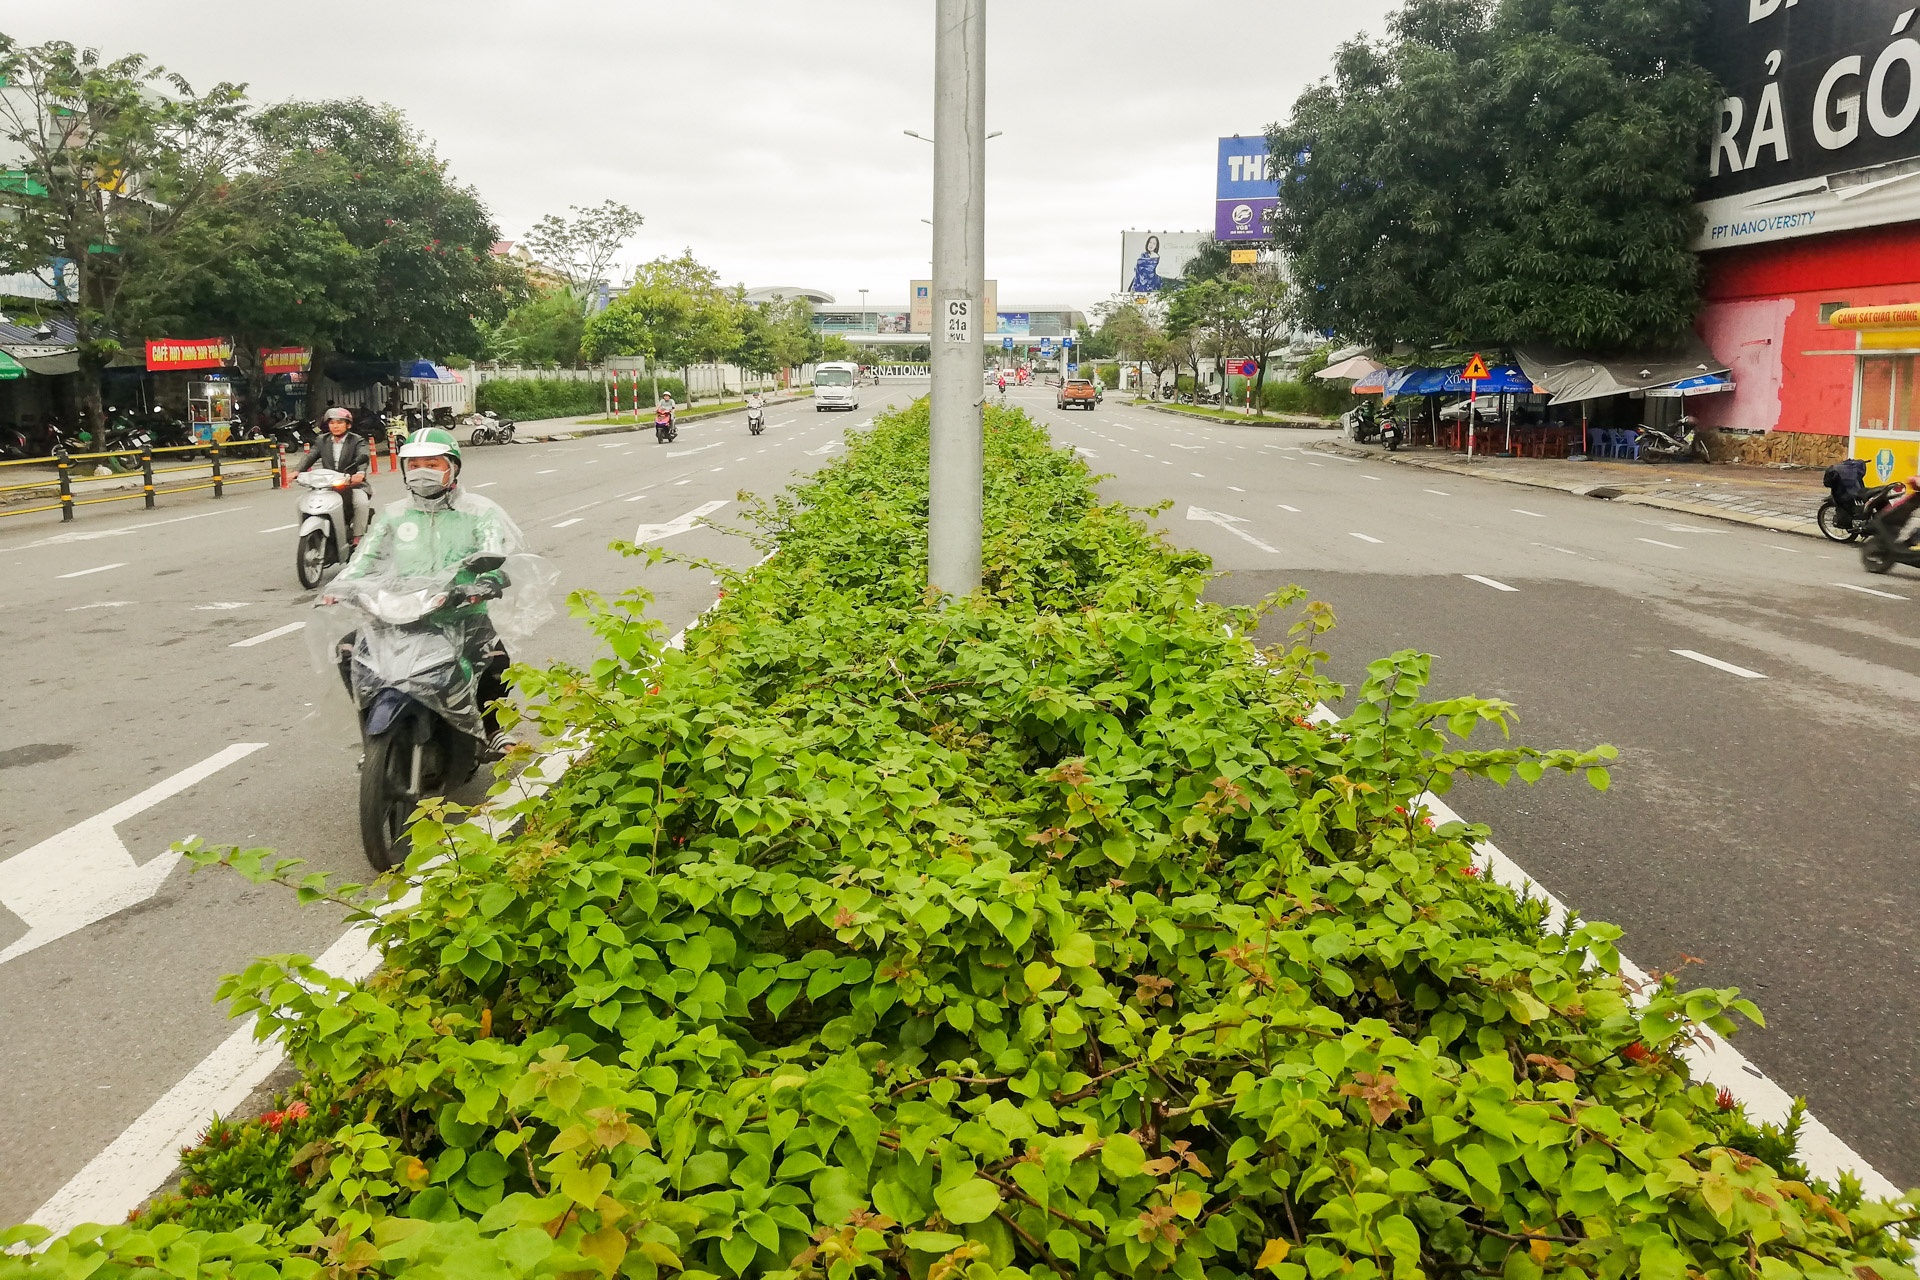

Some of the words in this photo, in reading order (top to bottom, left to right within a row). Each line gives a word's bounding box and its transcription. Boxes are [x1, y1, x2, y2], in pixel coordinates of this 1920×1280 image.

[1711, 224, 1729, 240] FPT
[1731, 211, 1816, 237] NANOVERSITY
[949, 302, 967, 316] CS
[1873, 311, 1890, 322] GIAO
[949, 319, 967, 331] 21a
